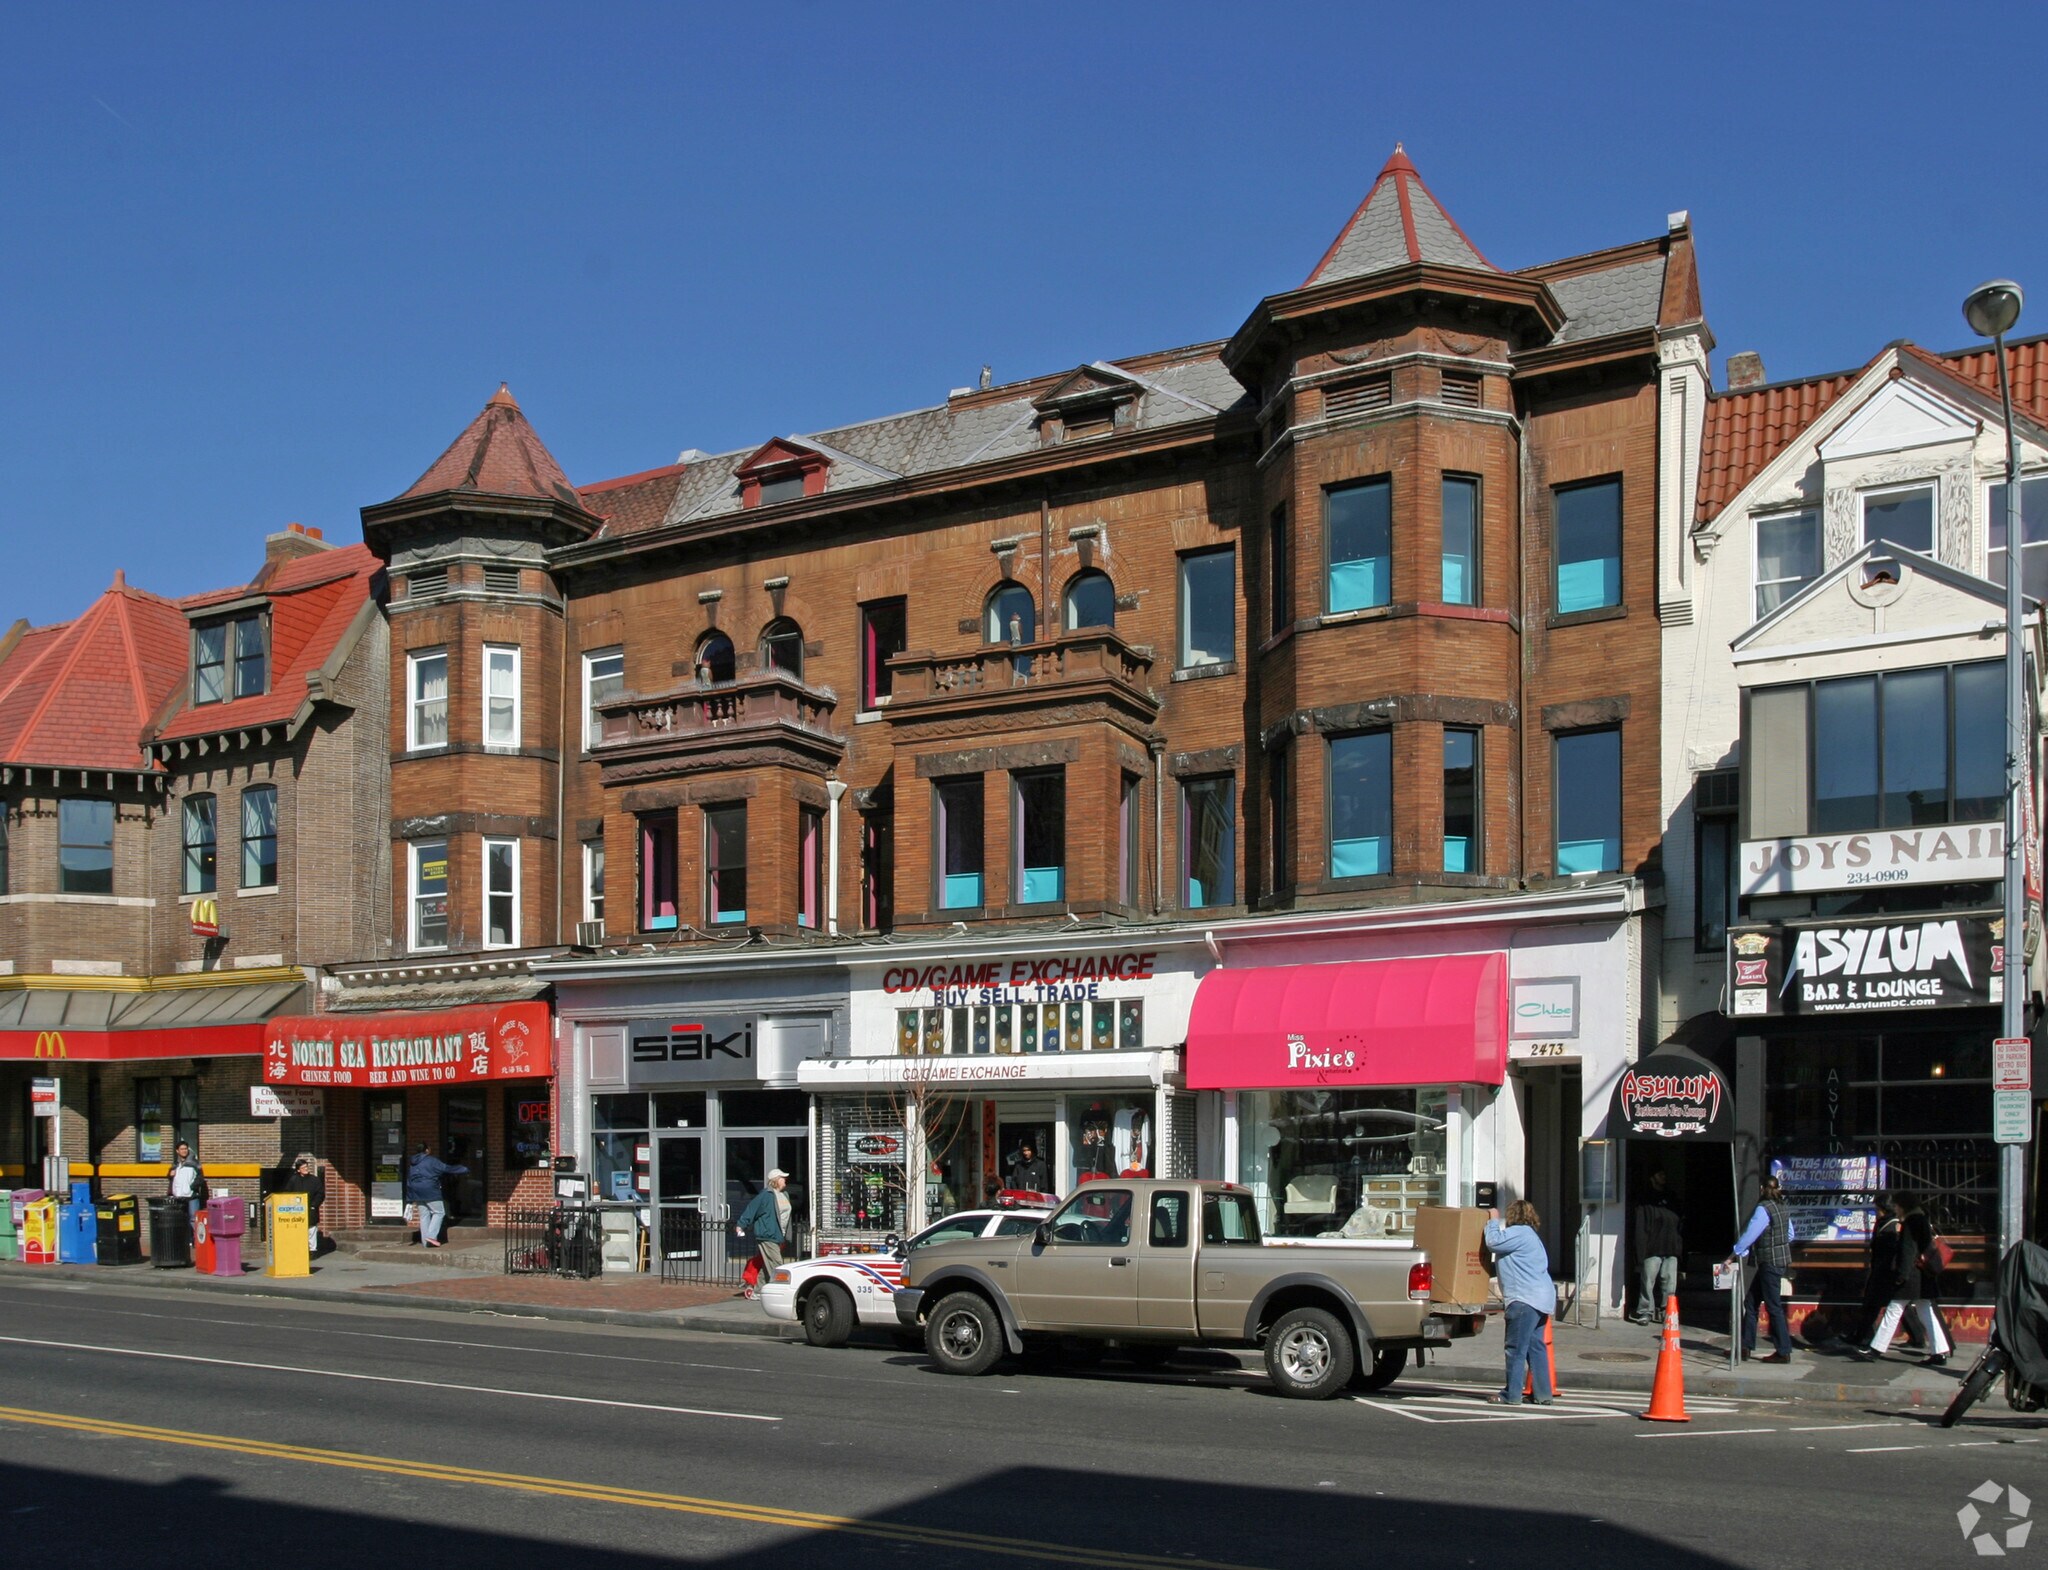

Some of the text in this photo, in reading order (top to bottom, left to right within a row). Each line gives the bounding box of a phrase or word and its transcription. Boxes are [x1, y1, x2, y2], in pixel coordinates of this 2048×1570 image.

[1750, 836, 1871, 874] JOYS
[1847, 870, 1909, 884] 234-0909
[423, 902, 447, 914] FedE
[1779, 920, 1973, 999] ASYLUM
[883, 952, 1156, 994] CD/GAME EXCHANGE
[934, 983, 1099, 1006] BUY SELL TRADE
[1803, 982, 1840, 1001] BAR
[1866, 978, 1944, 1000] LOUNGE
[1517, 1003, 1572, 1017] Chloe
[1814, 999, 1936, 1011] www.AsylumDC.com
[269, 1040, 287, 1079] 北海
[292, 1034, 462, 1068] NORTH SEA RESTAURANT
[468, 1031, 490, 1075] 飯店
[1287, 1041, 1355, 1068] Pixie's
[1531, 1043, 1564, 1056] 2473
[301, 1066, 456, 1083] CHINESE FOOD BEER AND WINE TO GO
[961, 1065, 1027, 1079] EXCHANGE
[1621, 1070, 1721, 1123] ASYLUM
[1791, 1158, 1820, 1169] TEXAS
[1776, 1169, 1808, 1181] POKER
[1781, 1195, 1819, 1207] ONDAYS
